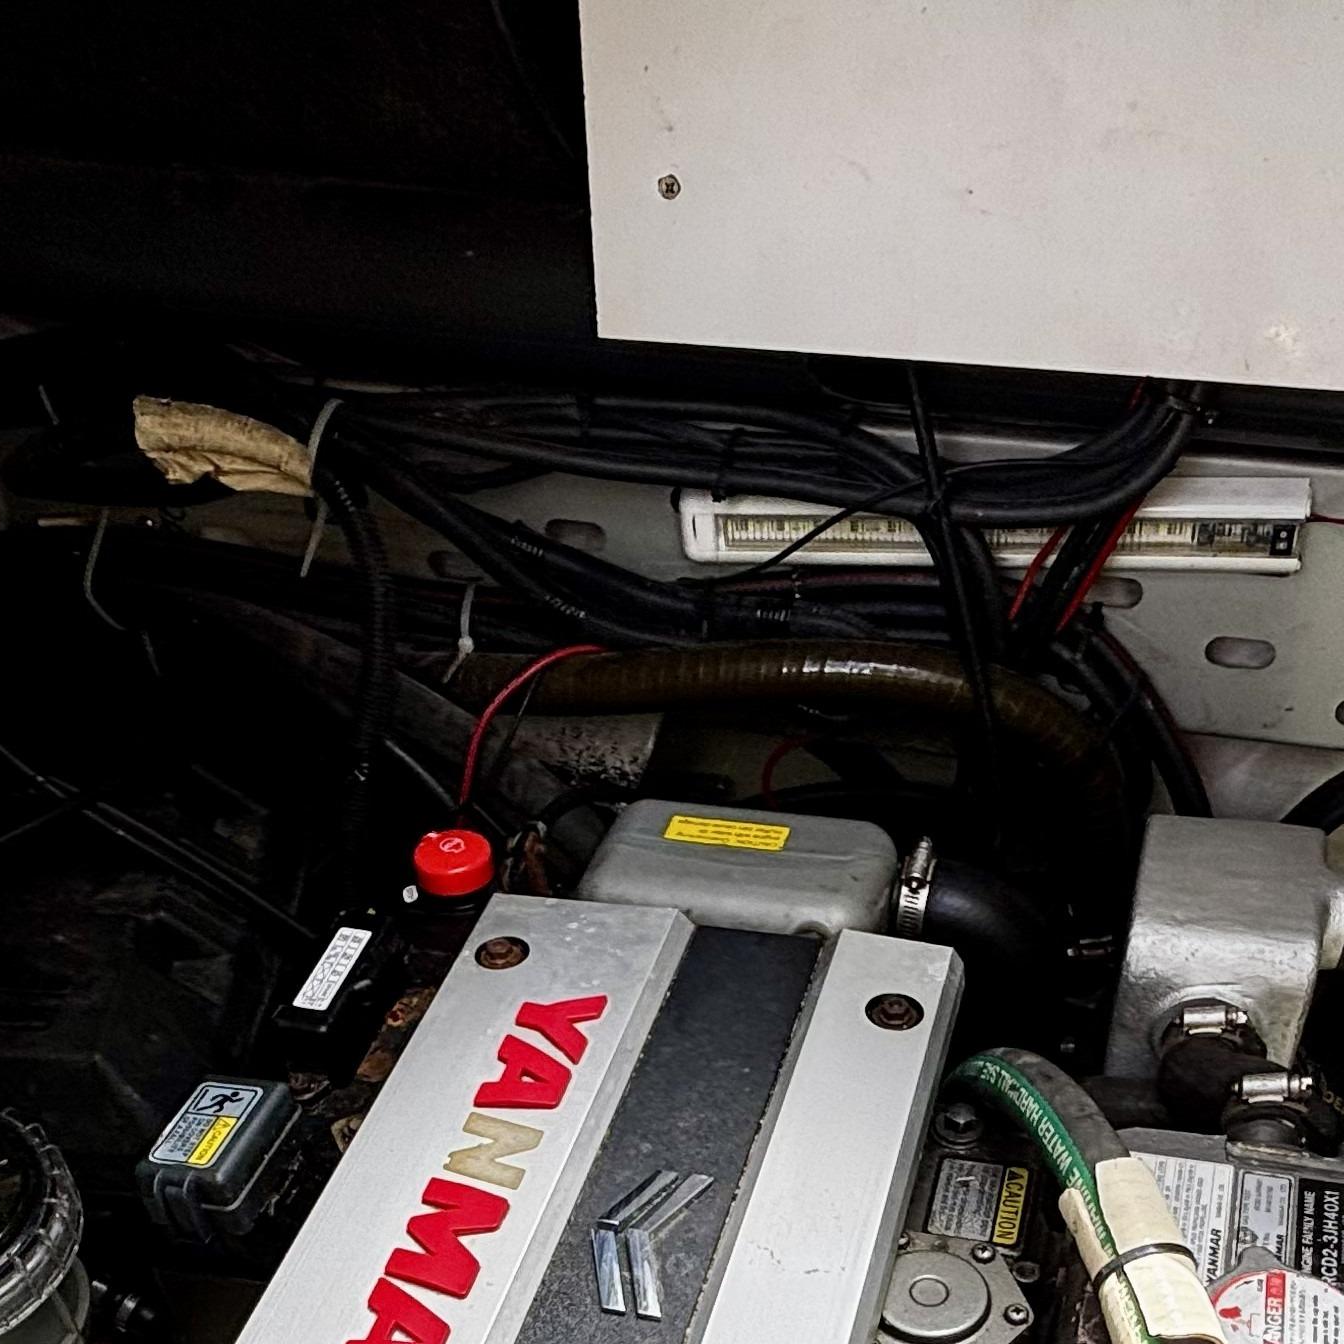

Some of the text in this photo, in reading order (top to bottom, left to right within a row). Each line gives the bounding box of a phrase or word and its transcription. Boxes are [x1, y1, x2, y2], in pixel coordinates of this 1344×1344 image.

[195, 1130, 222, 1160] CAUTION
[1038, 1117, 1072, 1175] WATER
[996, 1181, 1024, 1240] CAUTION
[1302, 1190, 1315, 1215] NAME
[1205, 1227, 1221, 1283] YANMAR
[1301, 1245, 1313, 1273] NGINE
